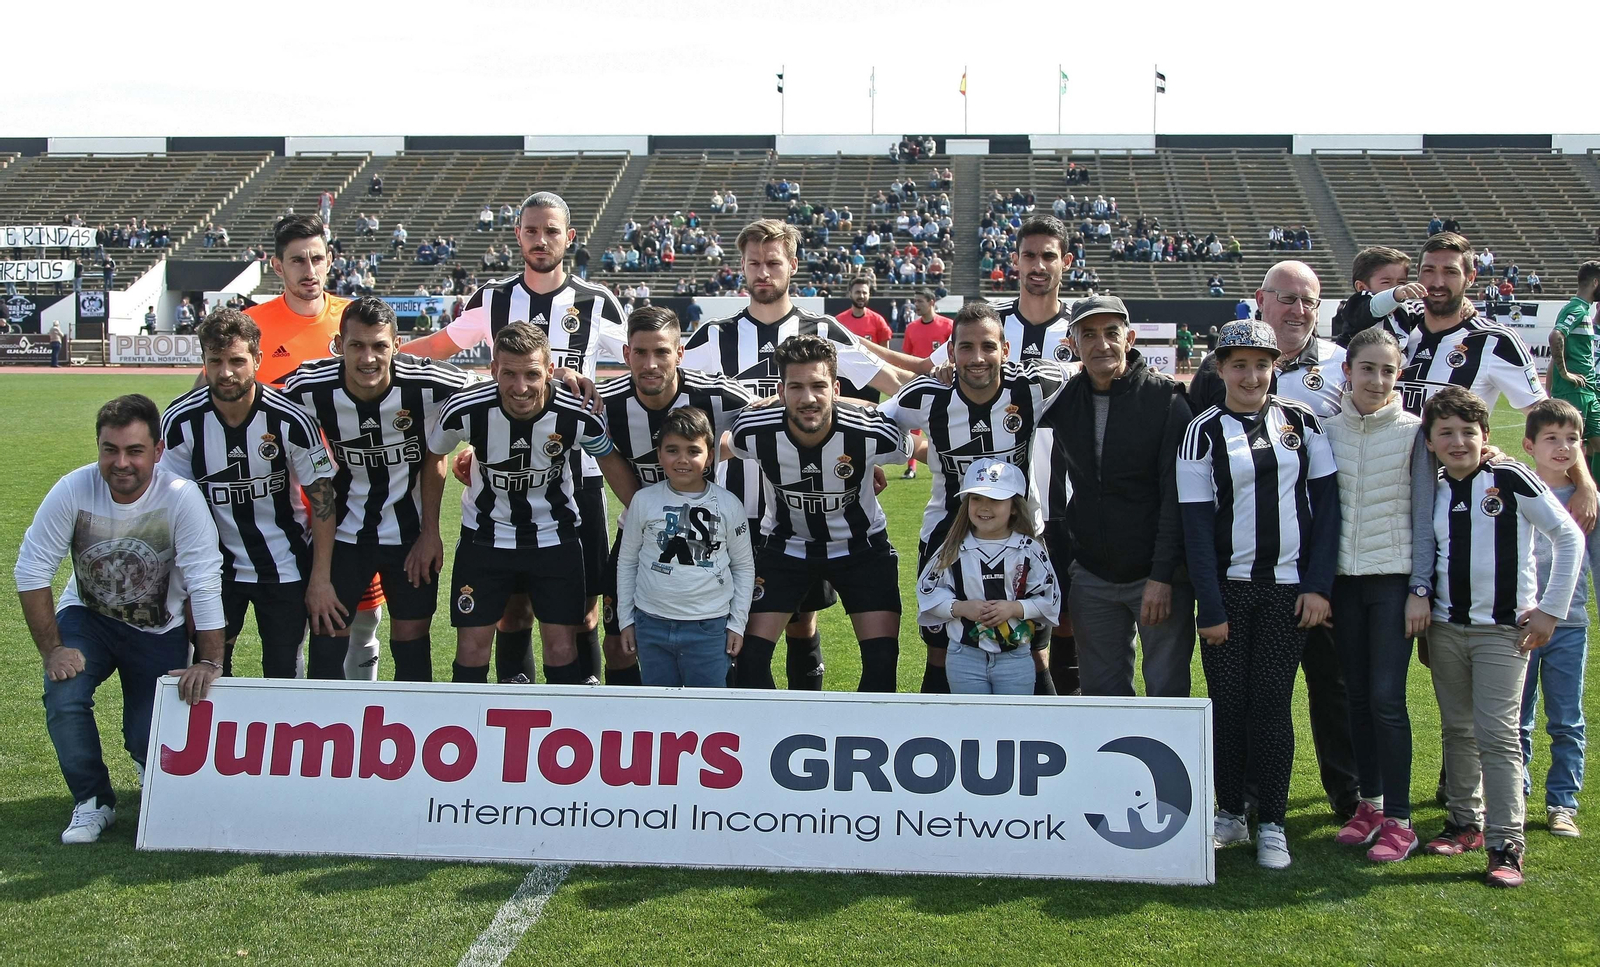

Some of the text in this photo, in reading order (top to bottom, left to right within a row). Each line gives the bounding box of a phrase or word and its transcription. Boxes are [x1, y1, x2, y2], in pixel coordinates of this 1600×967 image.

[23, 226, 91, 246] RINDAS
[199, 473, 286, 506] OTUS
[160, 700, 1067, 796] Jumbo Tours GROUP
[428, 797, 1067, 842] International Incoming Network
